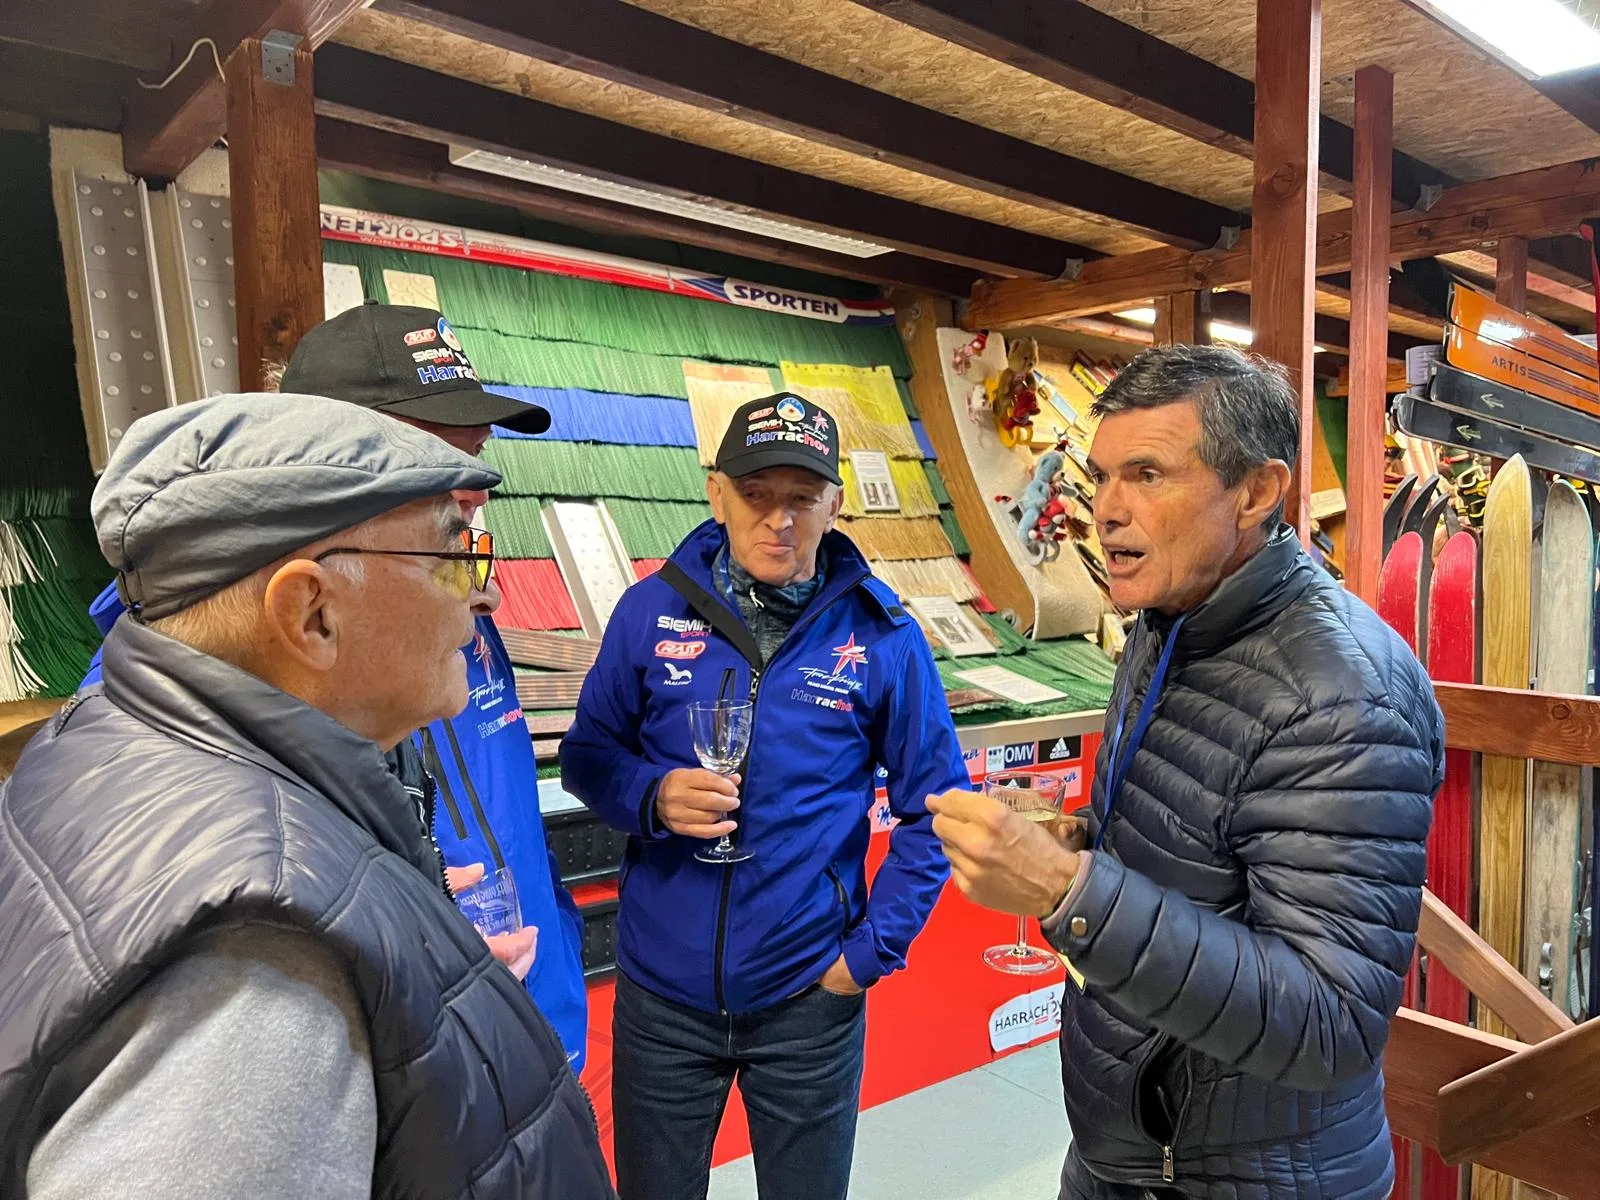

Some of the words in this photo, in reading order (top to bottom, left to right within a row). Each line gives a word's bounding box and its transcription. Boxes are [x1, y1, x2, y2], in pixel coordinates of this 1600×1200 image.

[733, 285, 840, 316] SPORTEN
[1491, 355, 1527, 377] ARTIS
[746, 431, 831, 456] Harrachov
[790, 688, 855, 713] Harracho
[1005, 744, 1034, 764] OMV
